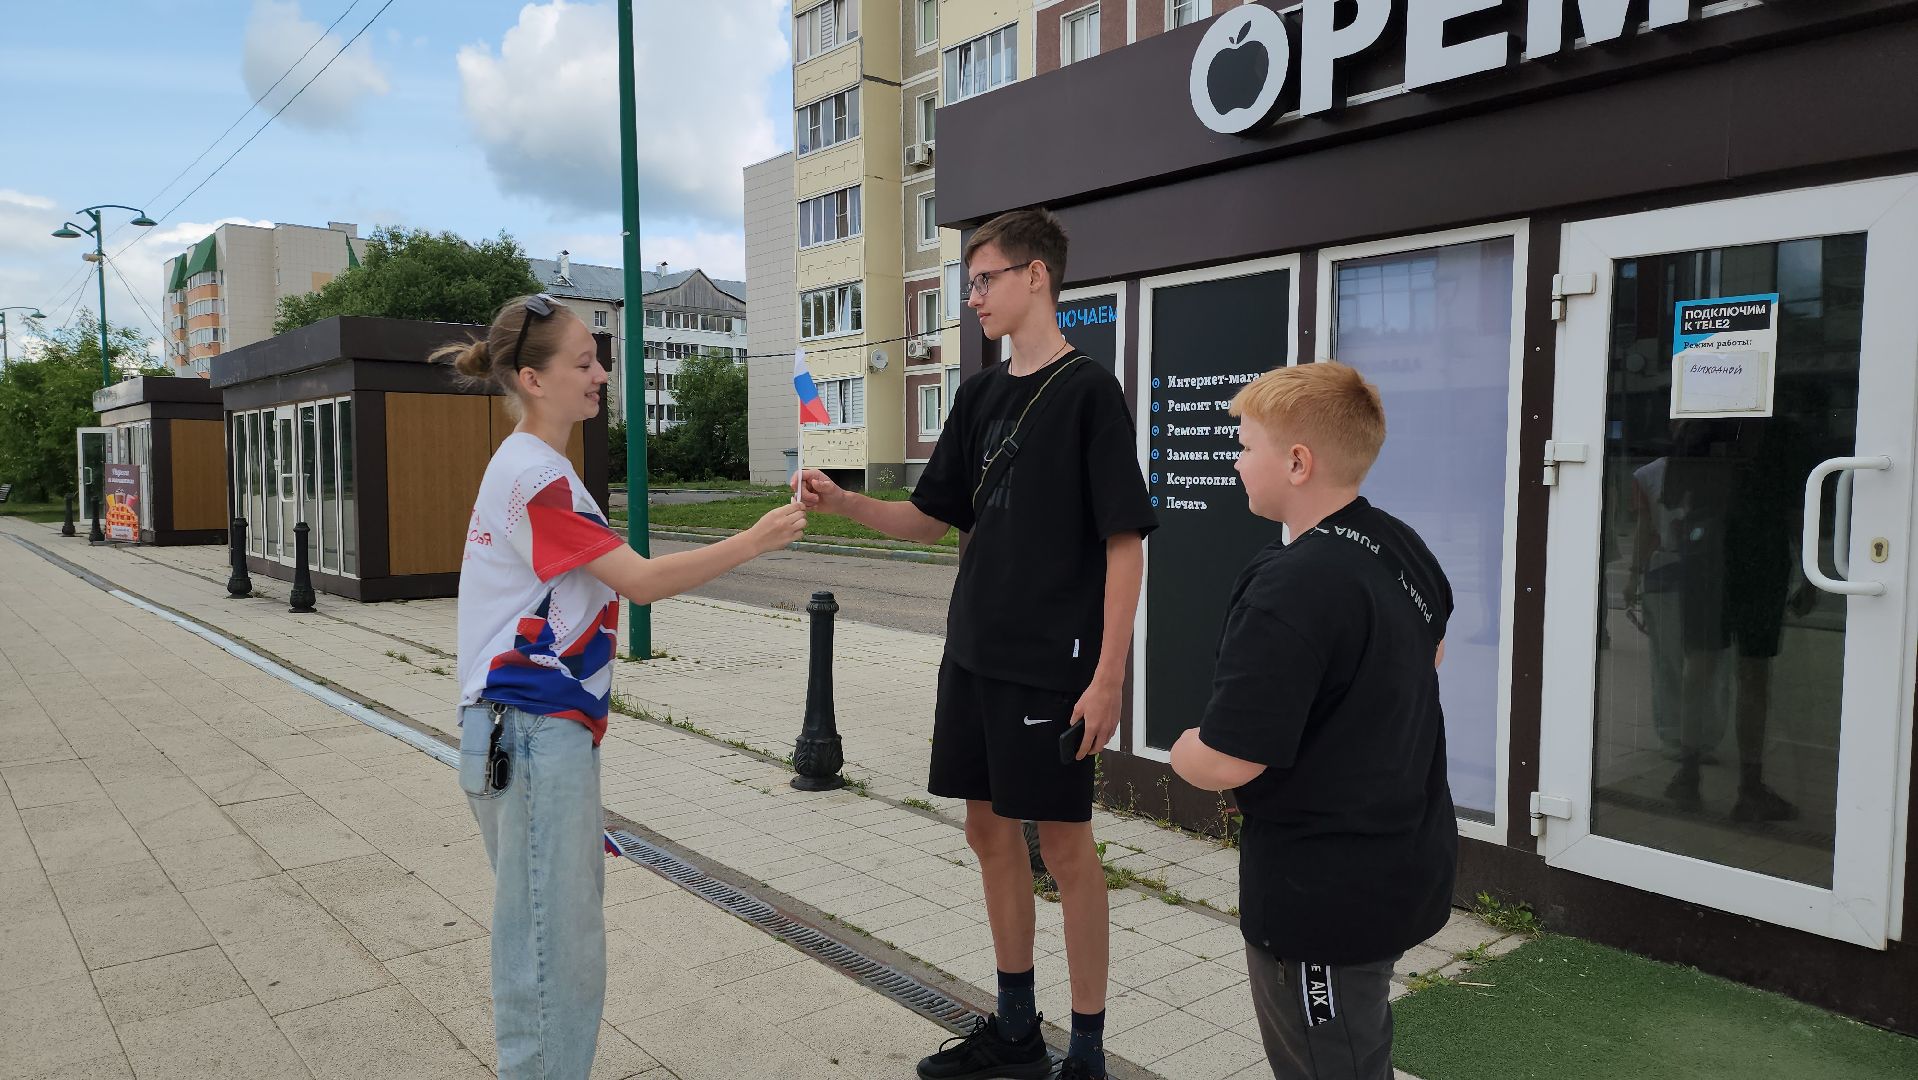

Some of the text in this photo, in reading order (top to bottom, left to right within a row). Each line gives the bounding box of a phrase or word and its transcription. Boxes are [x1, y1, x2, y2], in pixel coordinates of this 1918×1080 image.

[1685, 304, 1766, 320] ПОДКЛЮЧИМ
[1684, 318, 1730, 331] К TELE2
[1683, 339, 1752, 350] Режим работы:
[1167, 372, 1265, 390] Интернет-мага
[1167, 400, 1212, 413] Ремонт
[1167, 423, 1212, 437] Ремонт
[1166, 448, 1242, 461] Замена стек
[1166, 472, 1237, 489] Ксерокопия
[1166, 496, 1208, 510] Печать
[1334, 525, 1380, 555] PUMA
[1410, 583, 1433, 624] PUMA
